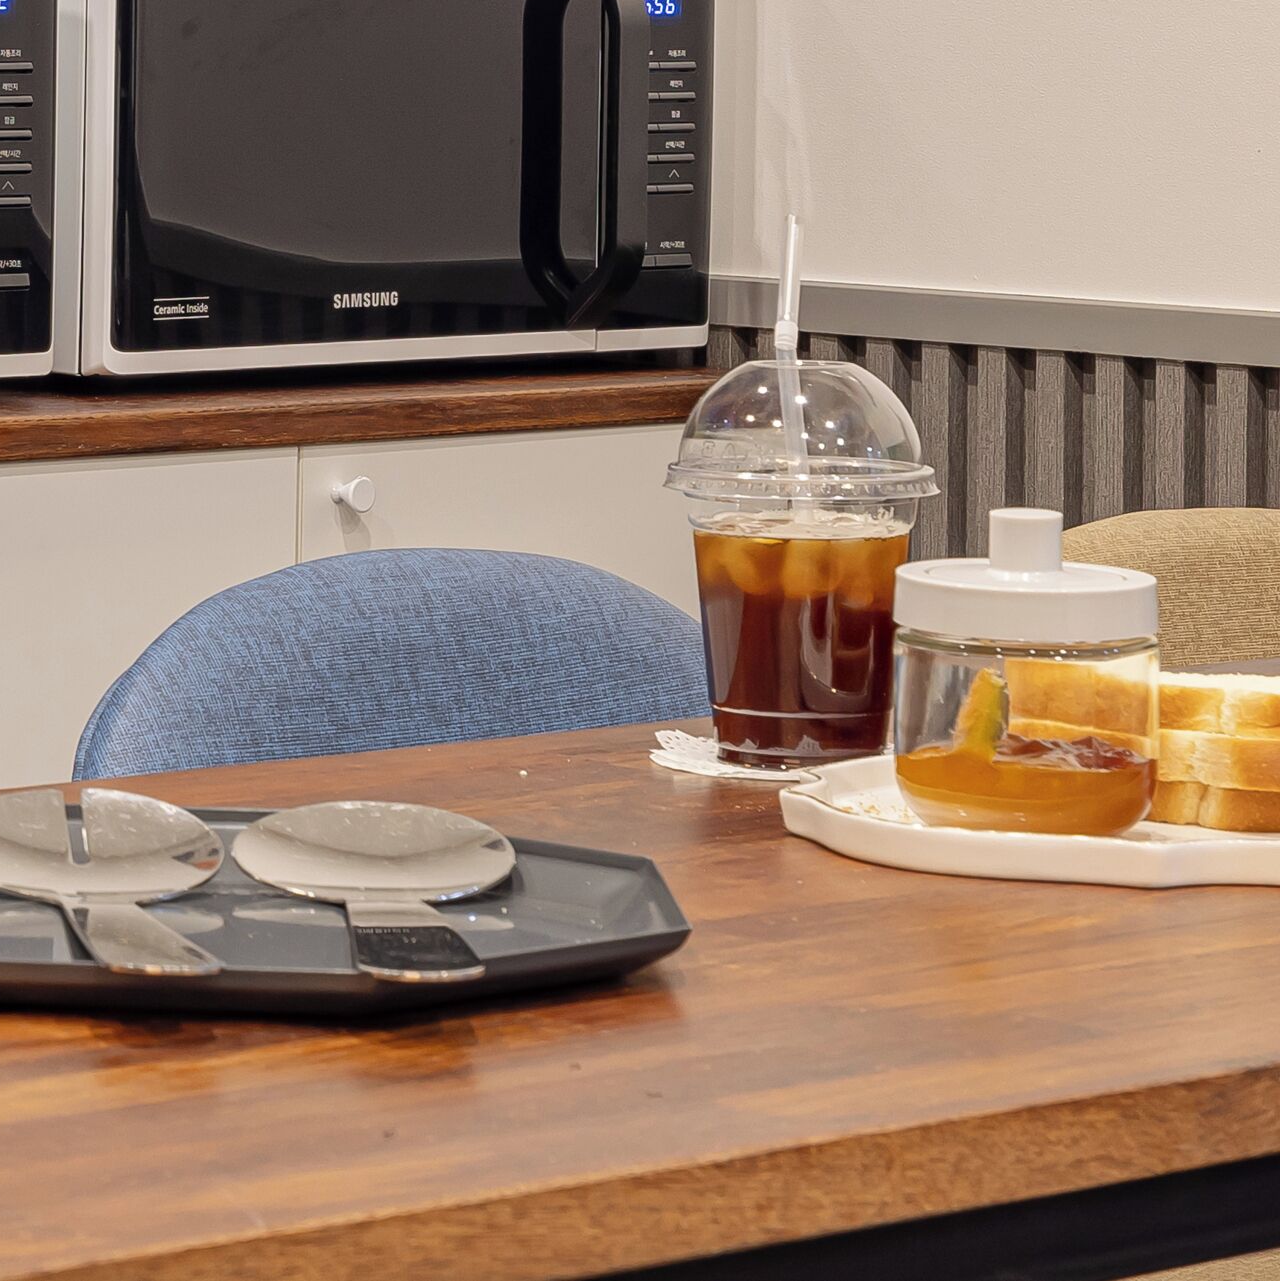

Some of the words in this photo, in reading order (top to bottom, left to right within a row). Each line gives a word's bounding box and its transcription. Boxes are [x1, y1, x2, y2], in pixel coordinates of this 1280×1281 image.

[333, 291, 399, 309] SAMSUNG
[153, 303, 185, 315] Ceramic
[186, 303, 209, 314] Inside
